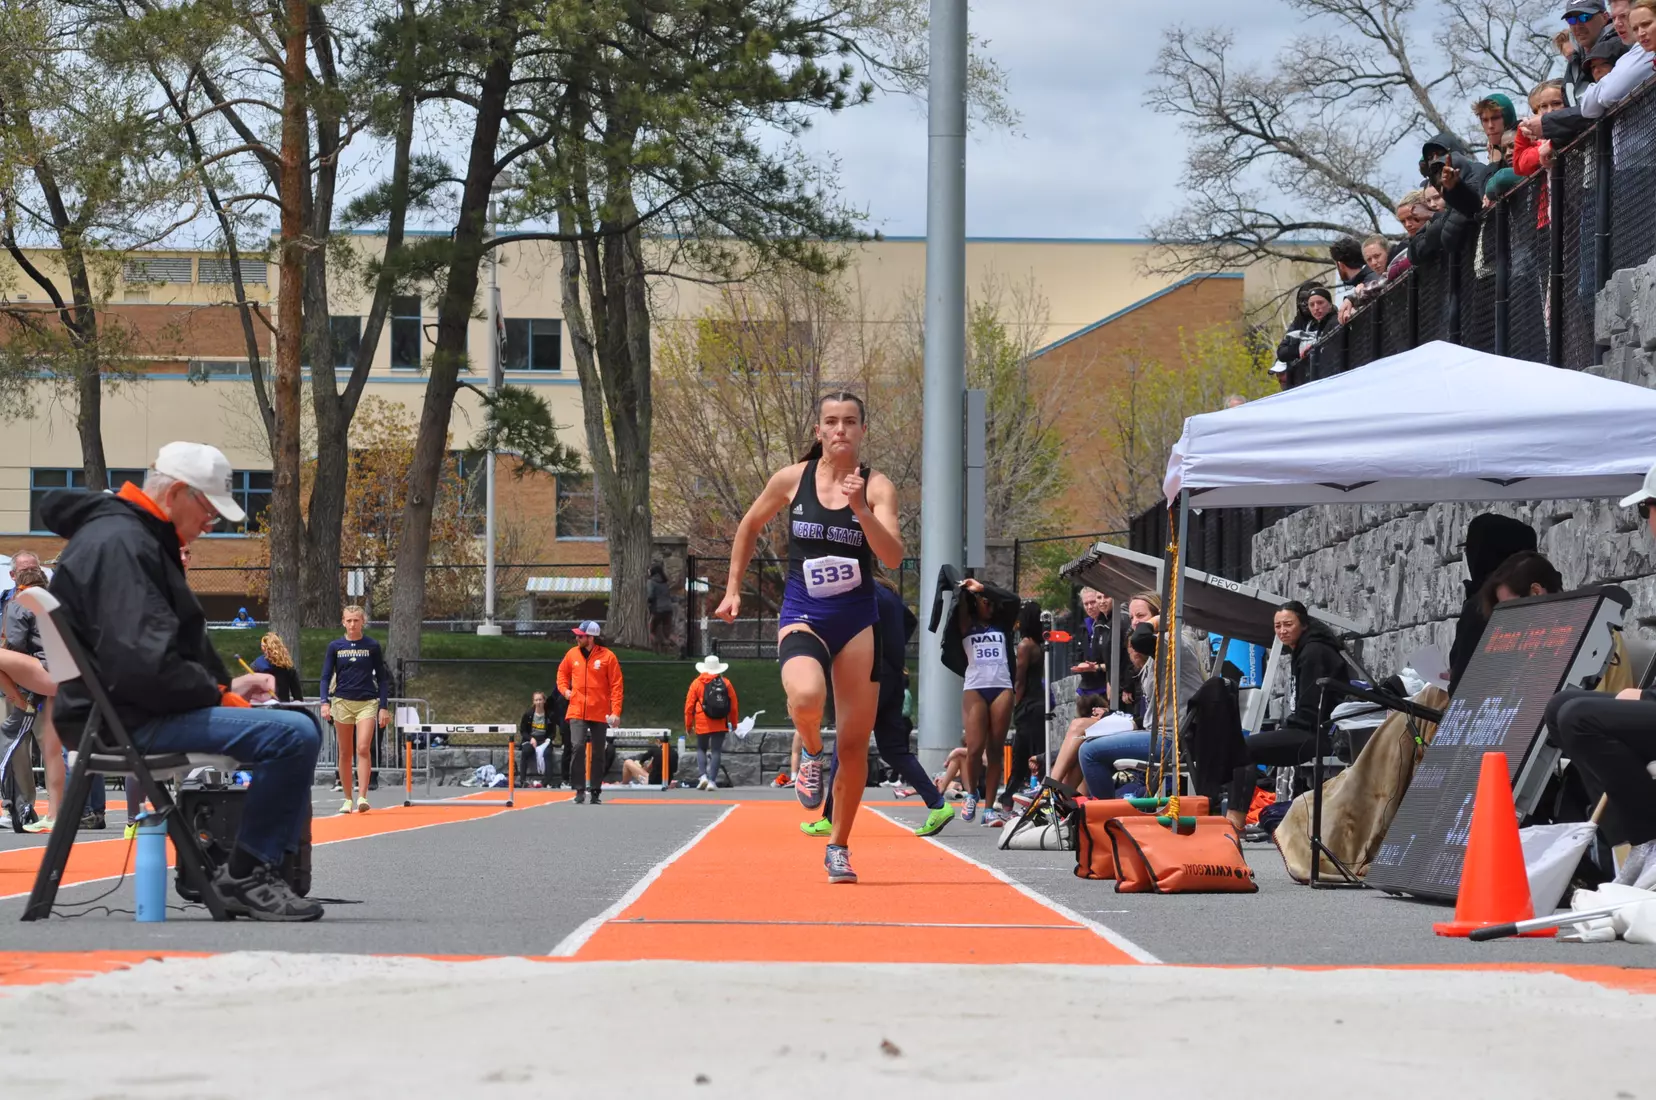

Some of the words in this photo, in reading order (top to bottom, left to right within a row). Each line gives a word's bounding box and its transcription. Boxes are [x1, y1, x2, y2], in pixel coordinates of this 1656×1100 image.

[826, 526, 863, 547] STATE
[811, 564, 854, 586] 533
[1210, 576, 1239, 592] PEVO
[970, 634, 1003, 646] NAU
[976, 648, 1000, 659] 366
[1464, 697, 1524, 746] Gilbert
